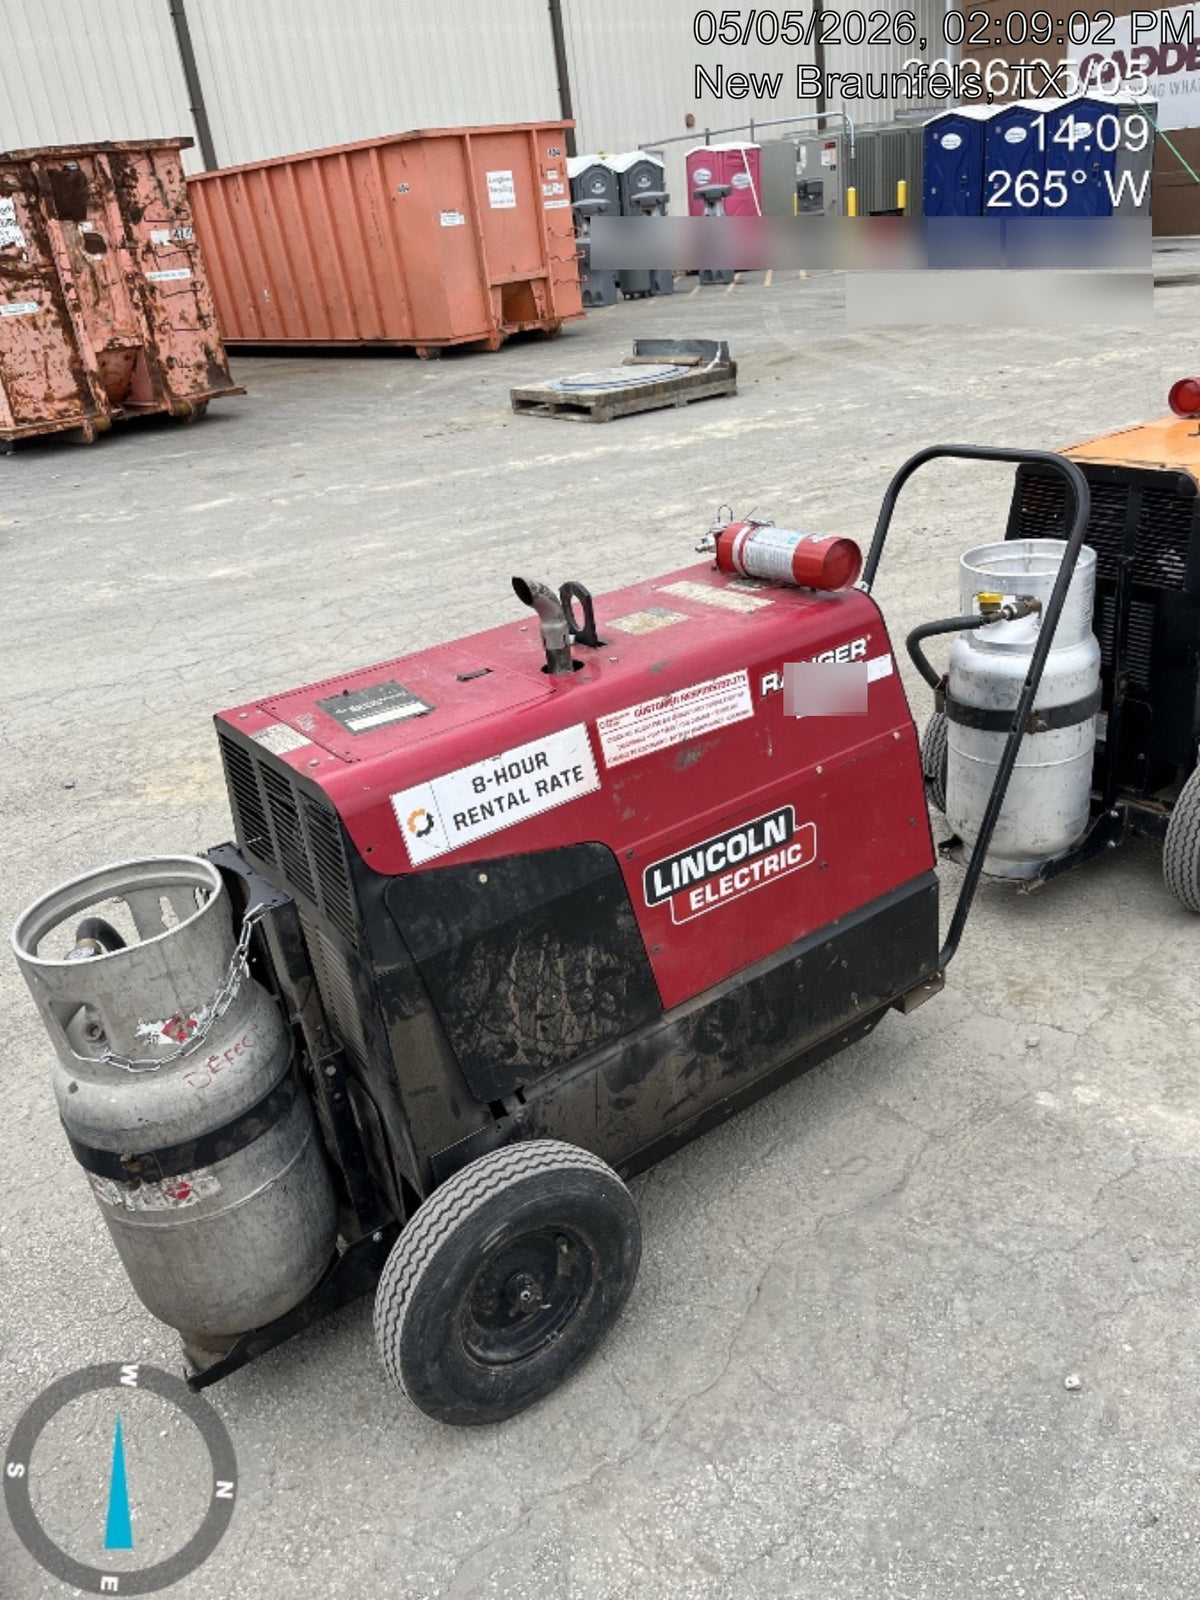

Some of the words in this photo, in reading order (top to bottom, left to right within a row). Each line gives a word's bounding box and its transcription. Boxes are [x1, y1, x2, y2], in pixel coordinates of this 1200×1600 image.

[452, 788, 531, 831] RENTAL
[534, 765, 584, 798] RATE
[472, 751, 550, 794] 8-HOUR
[653, 814, 788, 898] LINCOLN
[689, 843, 803, 912] ELECTRIC
